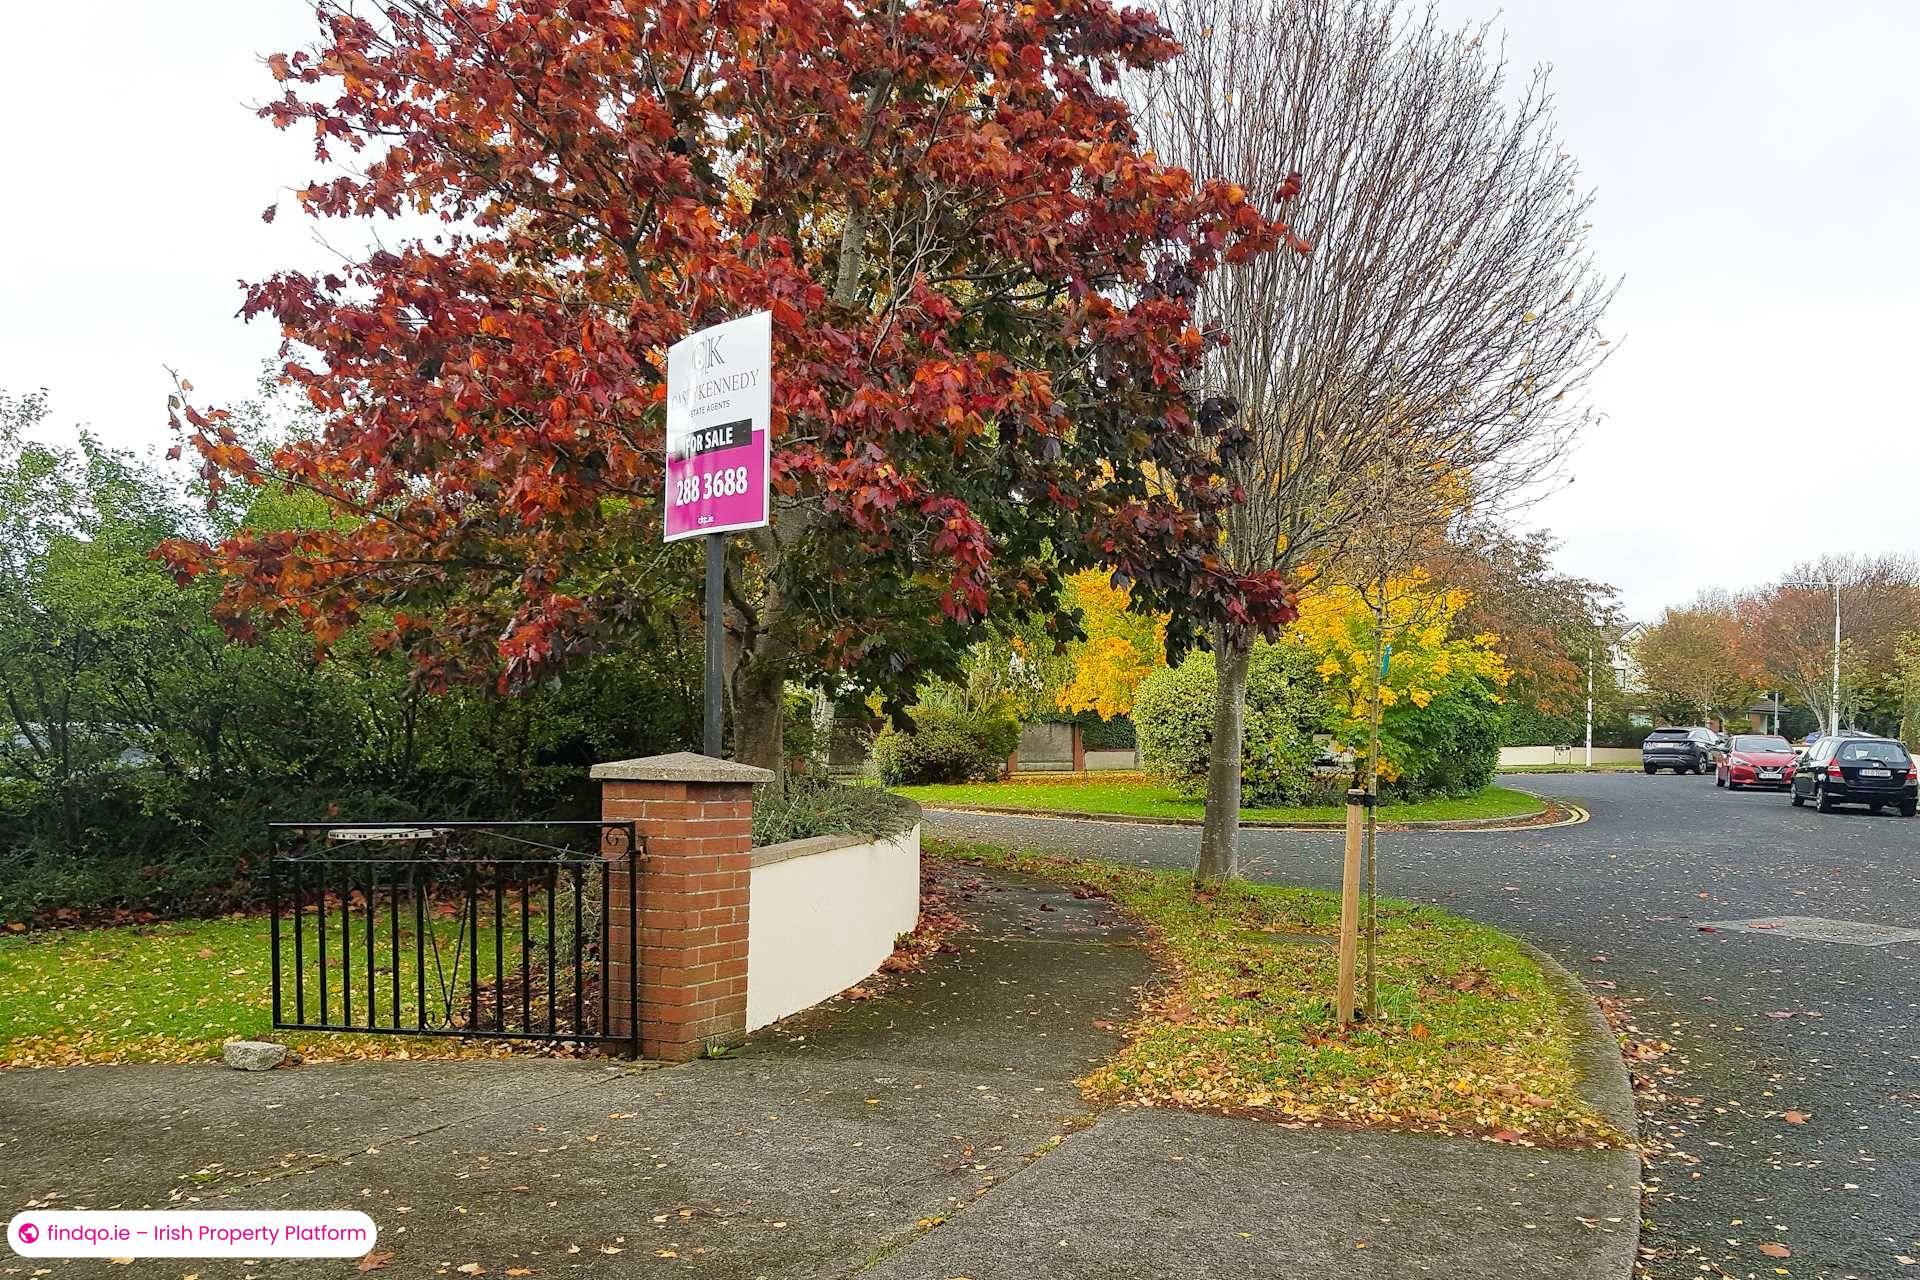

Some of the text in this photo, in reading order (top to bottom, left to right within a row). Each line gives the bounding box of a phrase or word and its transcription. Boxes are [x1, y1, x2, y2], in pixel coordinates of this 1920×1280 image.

[697, 369, 759, 400] KENNEDY
[706, 399, 730, 413] AGENTS
[685, 426, 734, 458] FOR SALE
[676, 466, 748, 507] 288 3688
